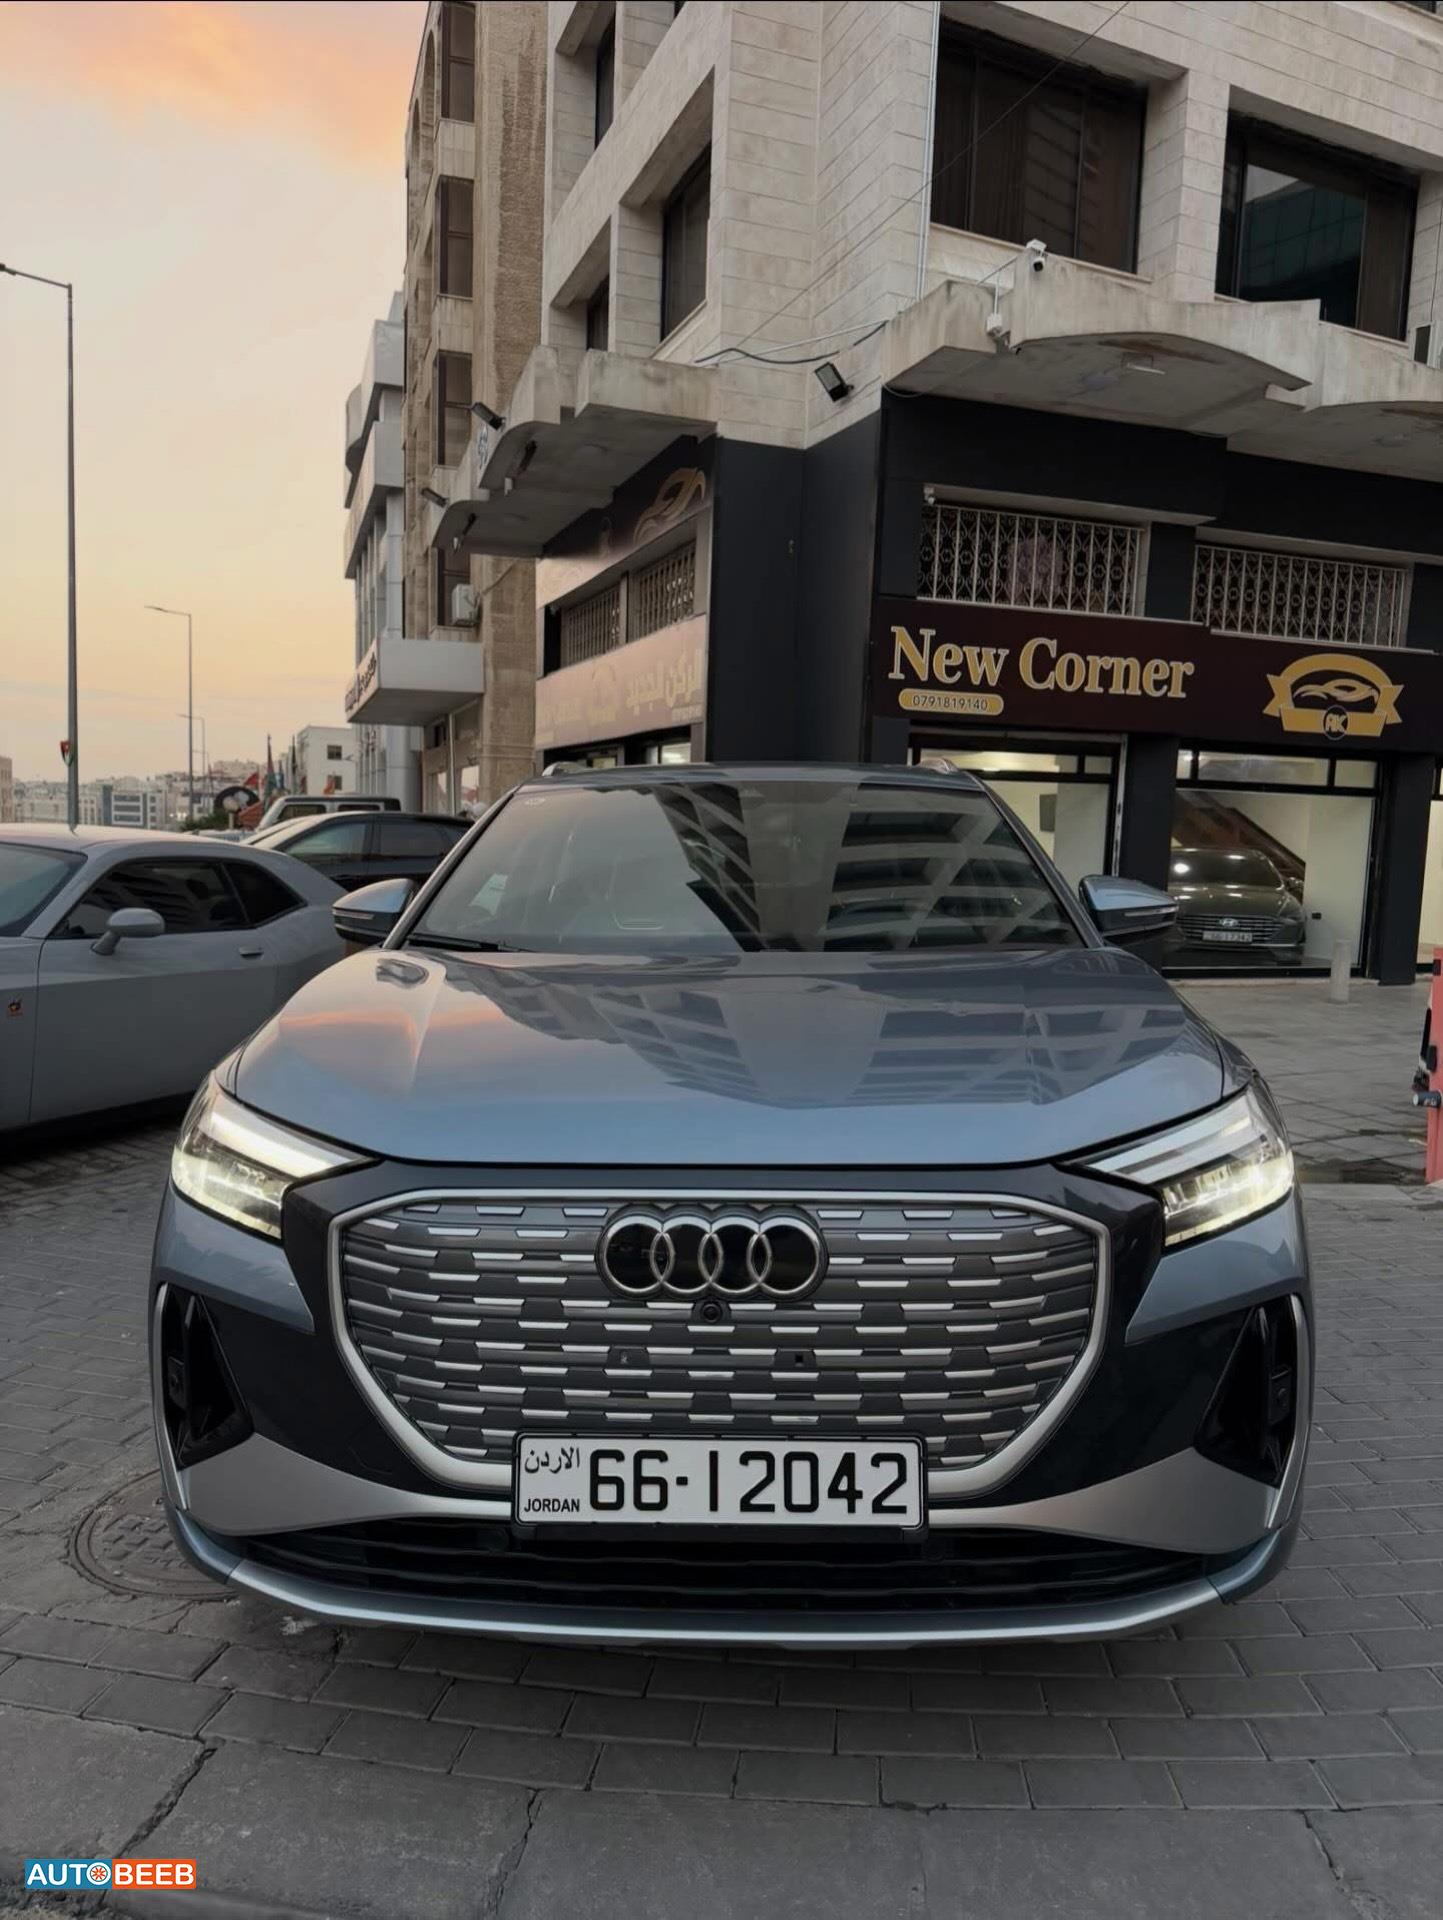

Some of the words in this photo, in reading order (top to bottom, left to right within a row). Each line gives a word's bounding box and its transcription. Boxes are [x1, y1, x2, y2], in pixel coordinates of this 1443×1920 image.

[888, 625, 1009, 688] New
[1018, 636, 1195, 699] Corner
[912, 694, 989, 711] 0791819140
[589, 1448, 907, 1514] 66-12042
[523, 1498, 580, 1512] JORDAN
